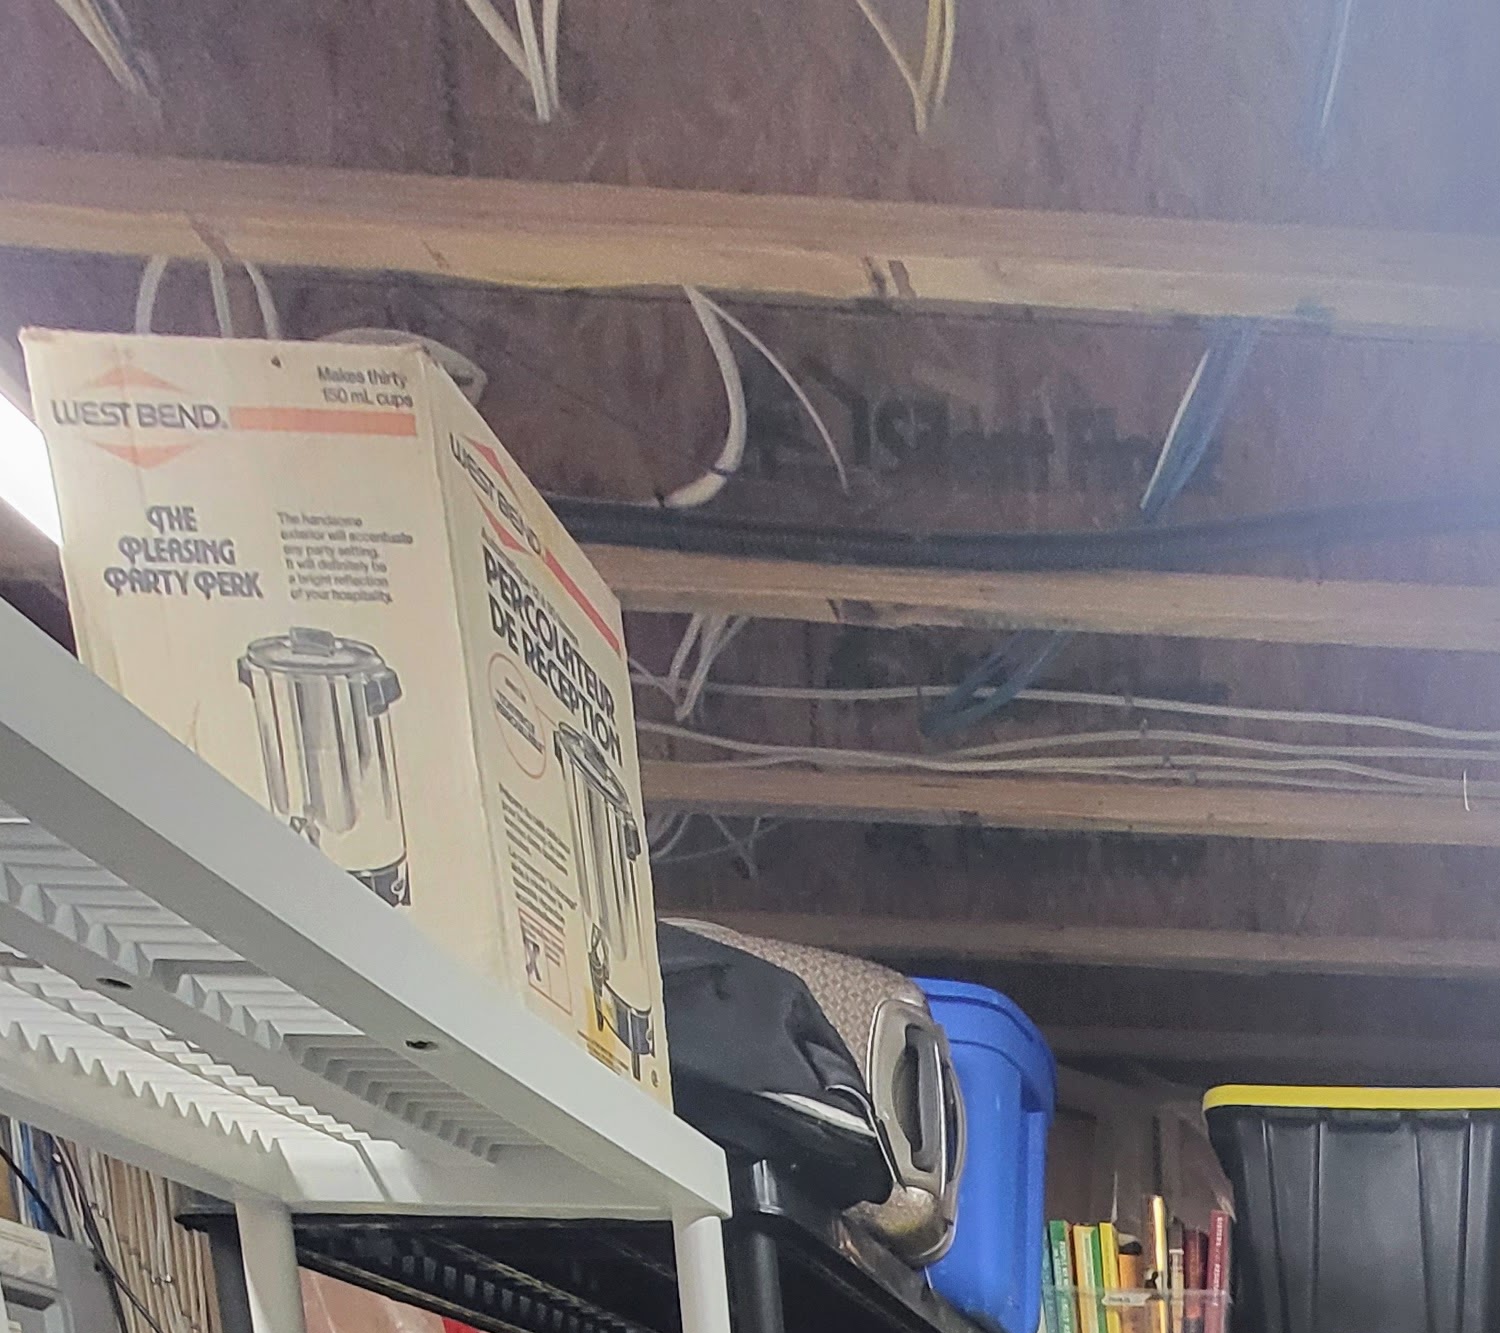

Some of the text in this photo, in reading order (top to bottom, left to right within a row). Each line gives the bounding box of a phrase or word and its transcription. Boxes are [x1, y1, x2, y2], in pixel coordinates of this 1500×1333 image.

[316, 366, 408, 389] Makes thirty
[51, 400, 221, 430] WEST BEND
[376, 393, 414, 408] cups
[449, 432, 496, 501] WEST
[497, 489, 543, 557] BEND
[146, 505, 198, 534] THE
[118, 535, 237, 565] PLEASING
[103, 566, 265, 601] PARTY PERK
[482, 543, 617, 727] PERCOLATEUR
[488, 591, 520, 656] DE
